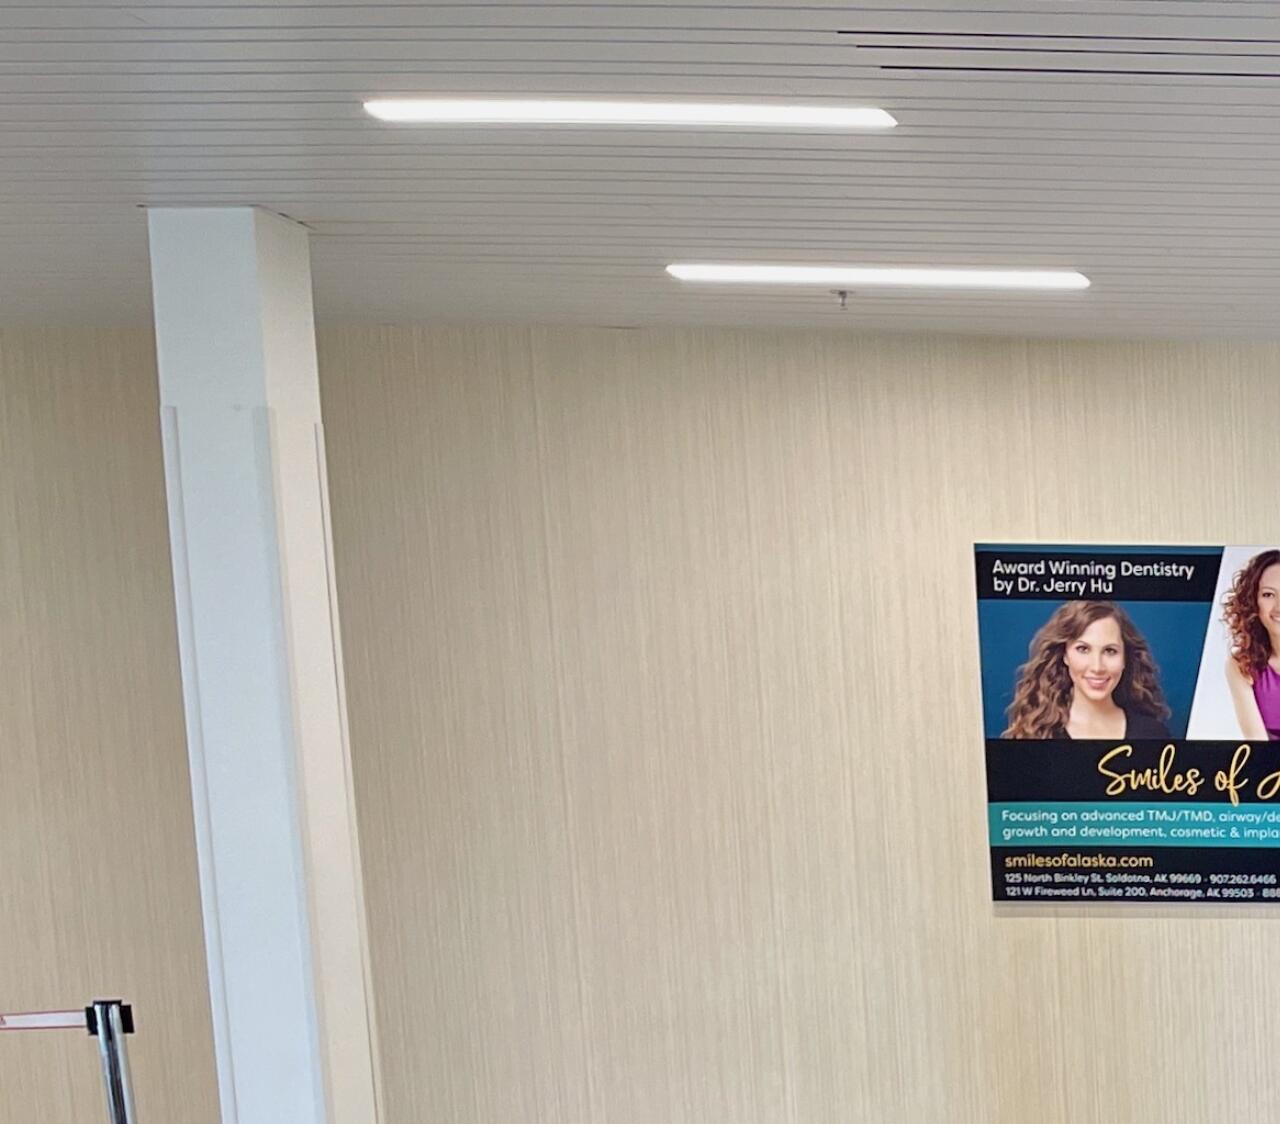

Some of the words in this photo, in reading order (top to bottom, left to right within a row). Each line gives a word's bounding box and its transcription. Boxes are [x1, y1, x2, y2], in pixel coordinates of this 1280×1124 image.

[992, 560, 1045, 575] Award
[1049, 560, 1116, 579] Winning
[1121, 562, 1194, 580] Dentistry
[993, 578, 1014, 595] by
[1018, 578, 1040, 593] Dr.
[1043, 578, 1086, 596] Jerry
[1091, 578, 1113, 593] Hu
[1098, 744, 1205, 795] Smiles
[1214, 744, 1251, 807] of
[1001, 810, 1058, 824] Focusing
[1061, 812, 1078, 821] on
[1080, 810, 1145, 822] advanced
[1147, 810, 1216, 823] TMJ/TMD,
[1002, 826, 1048, 840] growth
[1052, 826, 1077, 837] and
[1080, 827, 1167, 840] development,
[1170, 827, 1226, 838] cosmetic
[1230, 827, 1240, 838] &
[1005, 853, 1153, 867] smilesofalaska.com
[1005, 873, 1022, 883] 125
[1024, 873, 1053, 883] North
[1054, 873, 1089, 885] Binkley
[1154, 873, 1169, 883] AK
[1169, 873, 1201, 883] 99669
[1005, 887, 1021, 896] 121
[1022, 887, 1034, 896] W
[1034, 887, 1080, 896] Fireweed
[1098, 887, 1123, 896] Suite
[1206, 888, 1221, 898] AK
